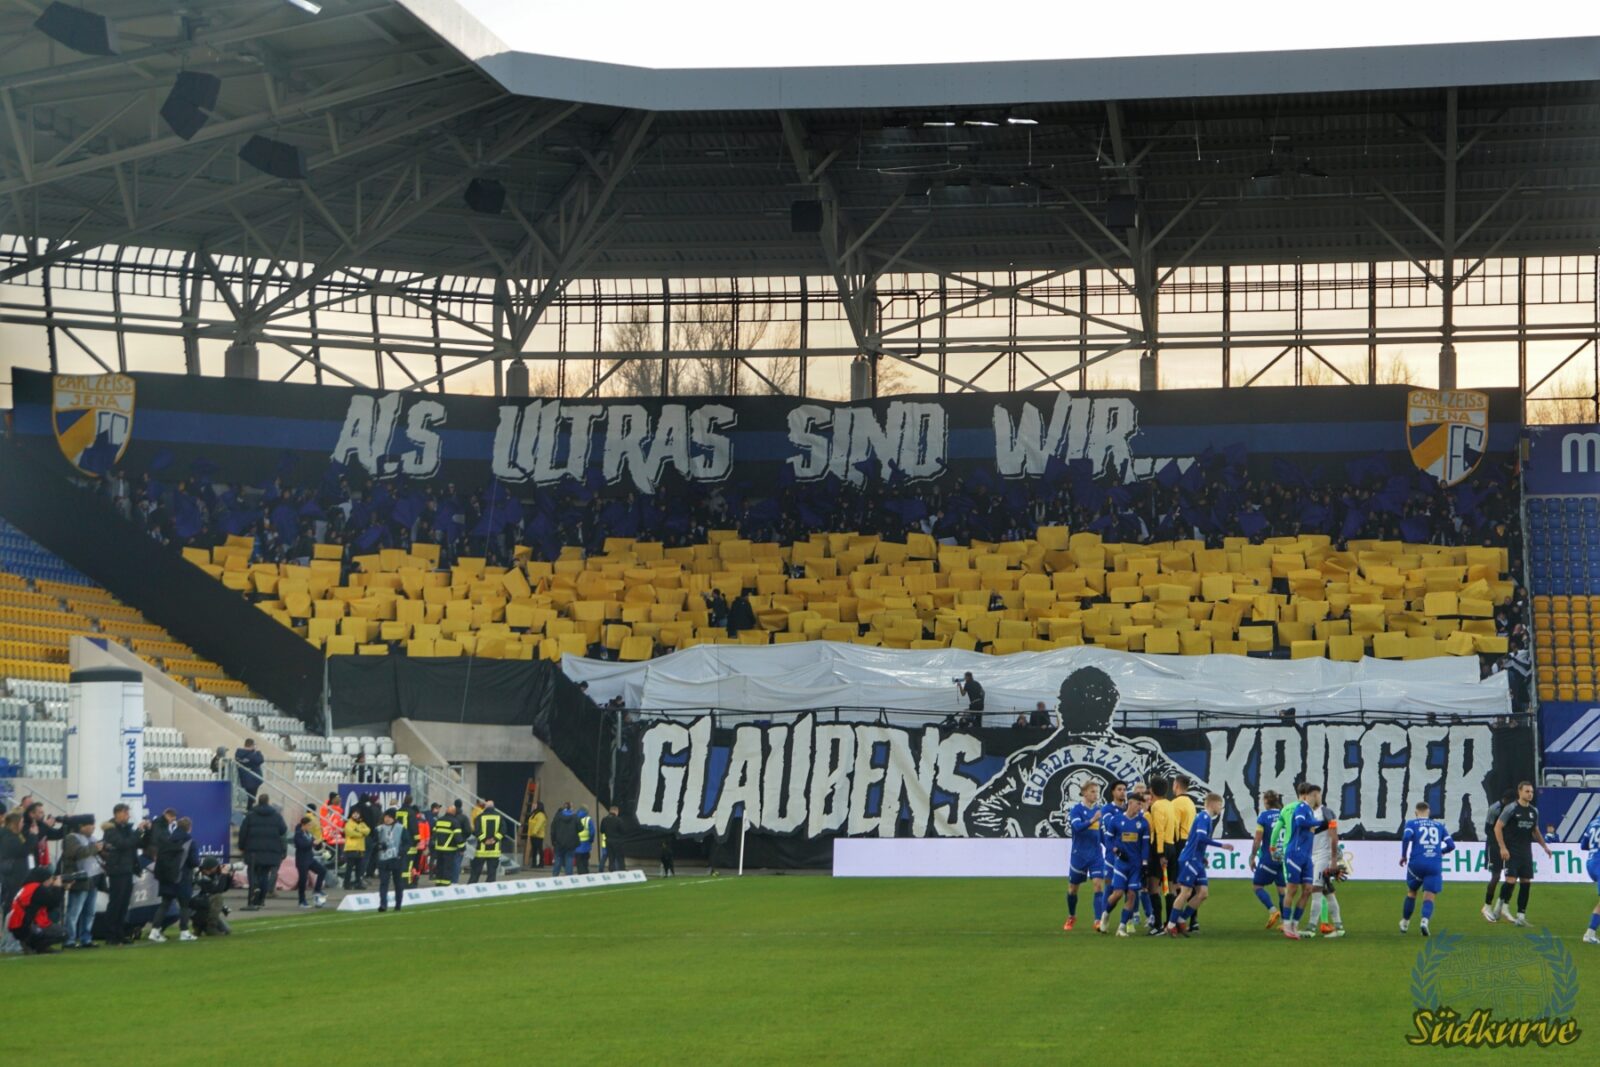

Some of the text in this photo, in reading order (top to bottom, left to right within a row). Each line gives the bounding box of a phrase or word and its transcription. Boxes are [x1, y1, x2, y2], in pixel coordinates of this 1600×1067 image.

[57, 375, 132, 392] CARL ZEISS
[69, 393, 119, 408] JENA
[1413, 391, 1484, 409] CARL ZEISS
[1424, 409, 1472, 423] JENA
[331, 392, 448, 480] ALS
[492, 398, 738, 496] ULTRAS
[786, 399, 949, 493] SIND
[126, 738, 136, 788] maxit
[636, 713, 1493, 842] GLAUBENS KRIEGER
[1024, 749, 1075, 802] HORDA
[1418, 826, 1439, 846] 29
